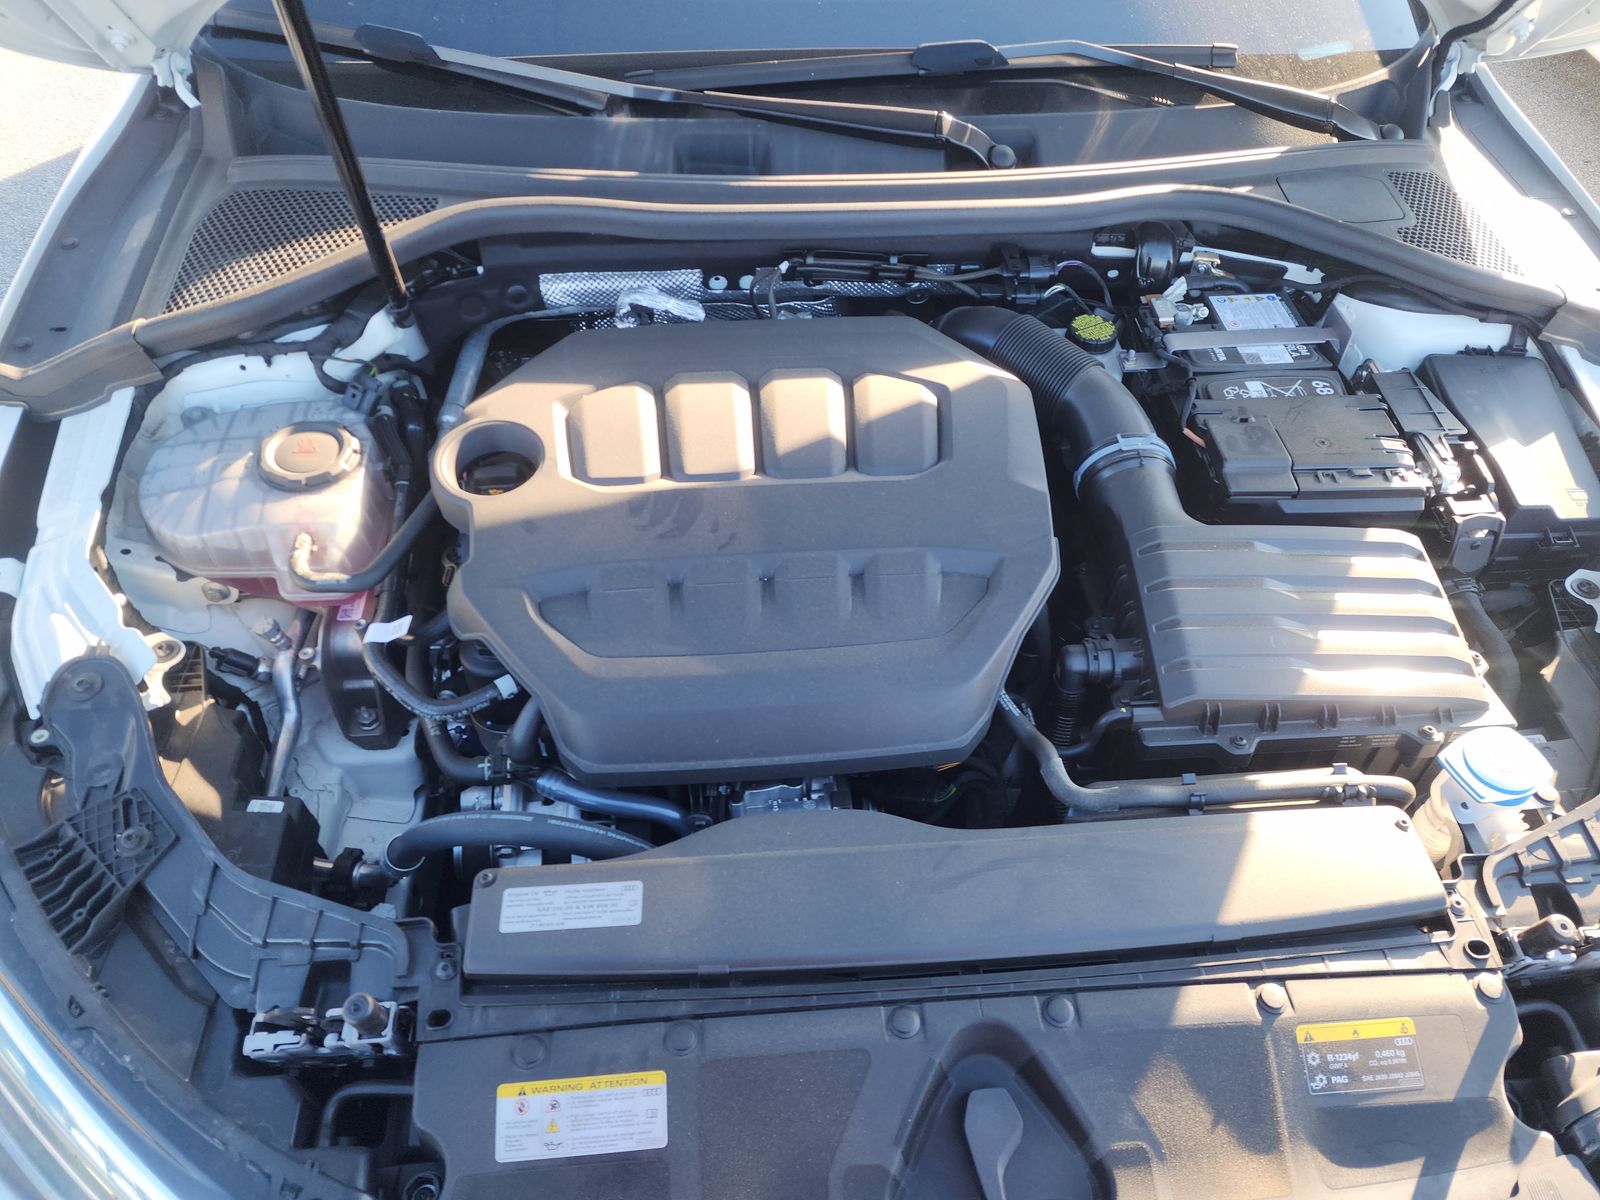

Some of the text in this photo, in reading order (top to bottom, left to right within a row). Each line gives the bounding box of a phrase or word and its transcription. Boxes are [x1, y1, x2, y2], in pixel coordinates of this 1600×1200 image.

[1311, 380, 1335, 396] 68
[531, 1077, 649, 1095] WARNING ATTENTION
[1331, 1075, 1349, 1085] PAG
